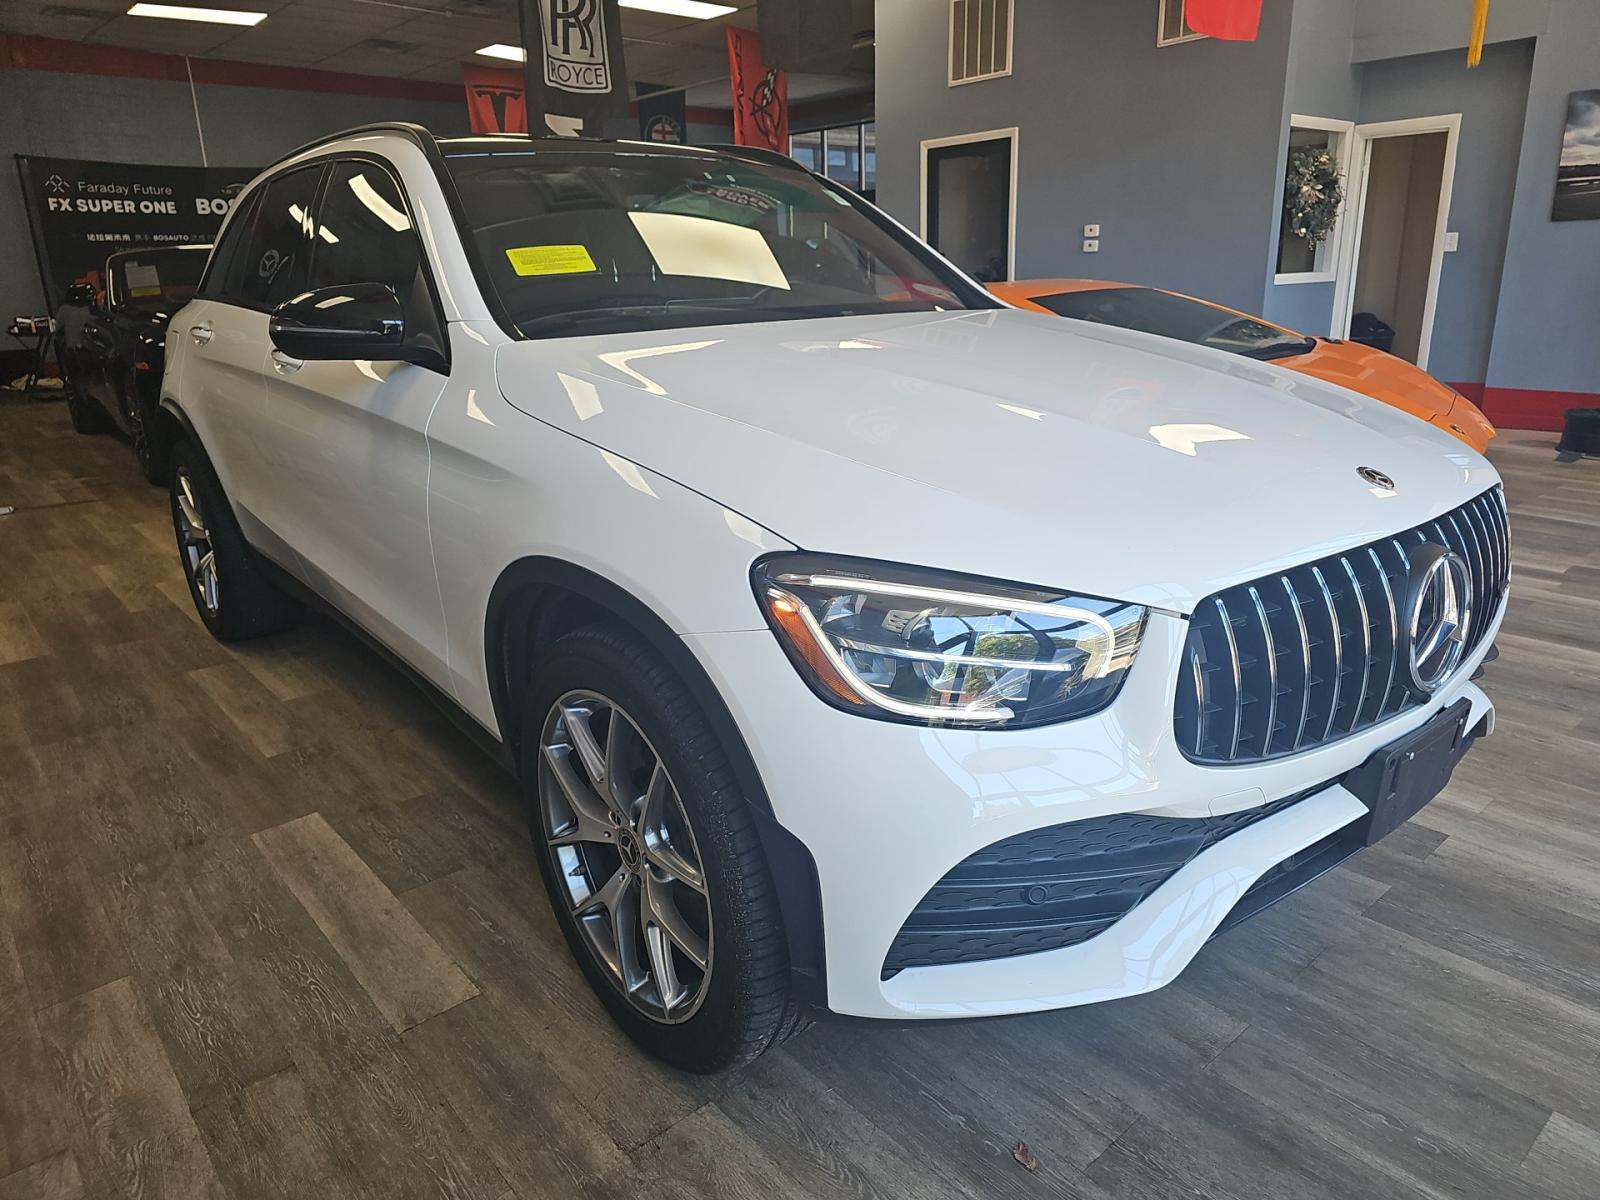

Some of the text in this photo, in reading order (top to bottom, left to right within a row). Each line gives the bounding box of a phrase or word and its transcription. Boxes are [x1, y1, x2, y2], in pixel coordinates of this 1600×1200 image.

[550, 60, 604, 85] ROYCE
[78, 181, 173, 196] Faraday Future
[48, 198, 177, 215] FX SUPER ONE
